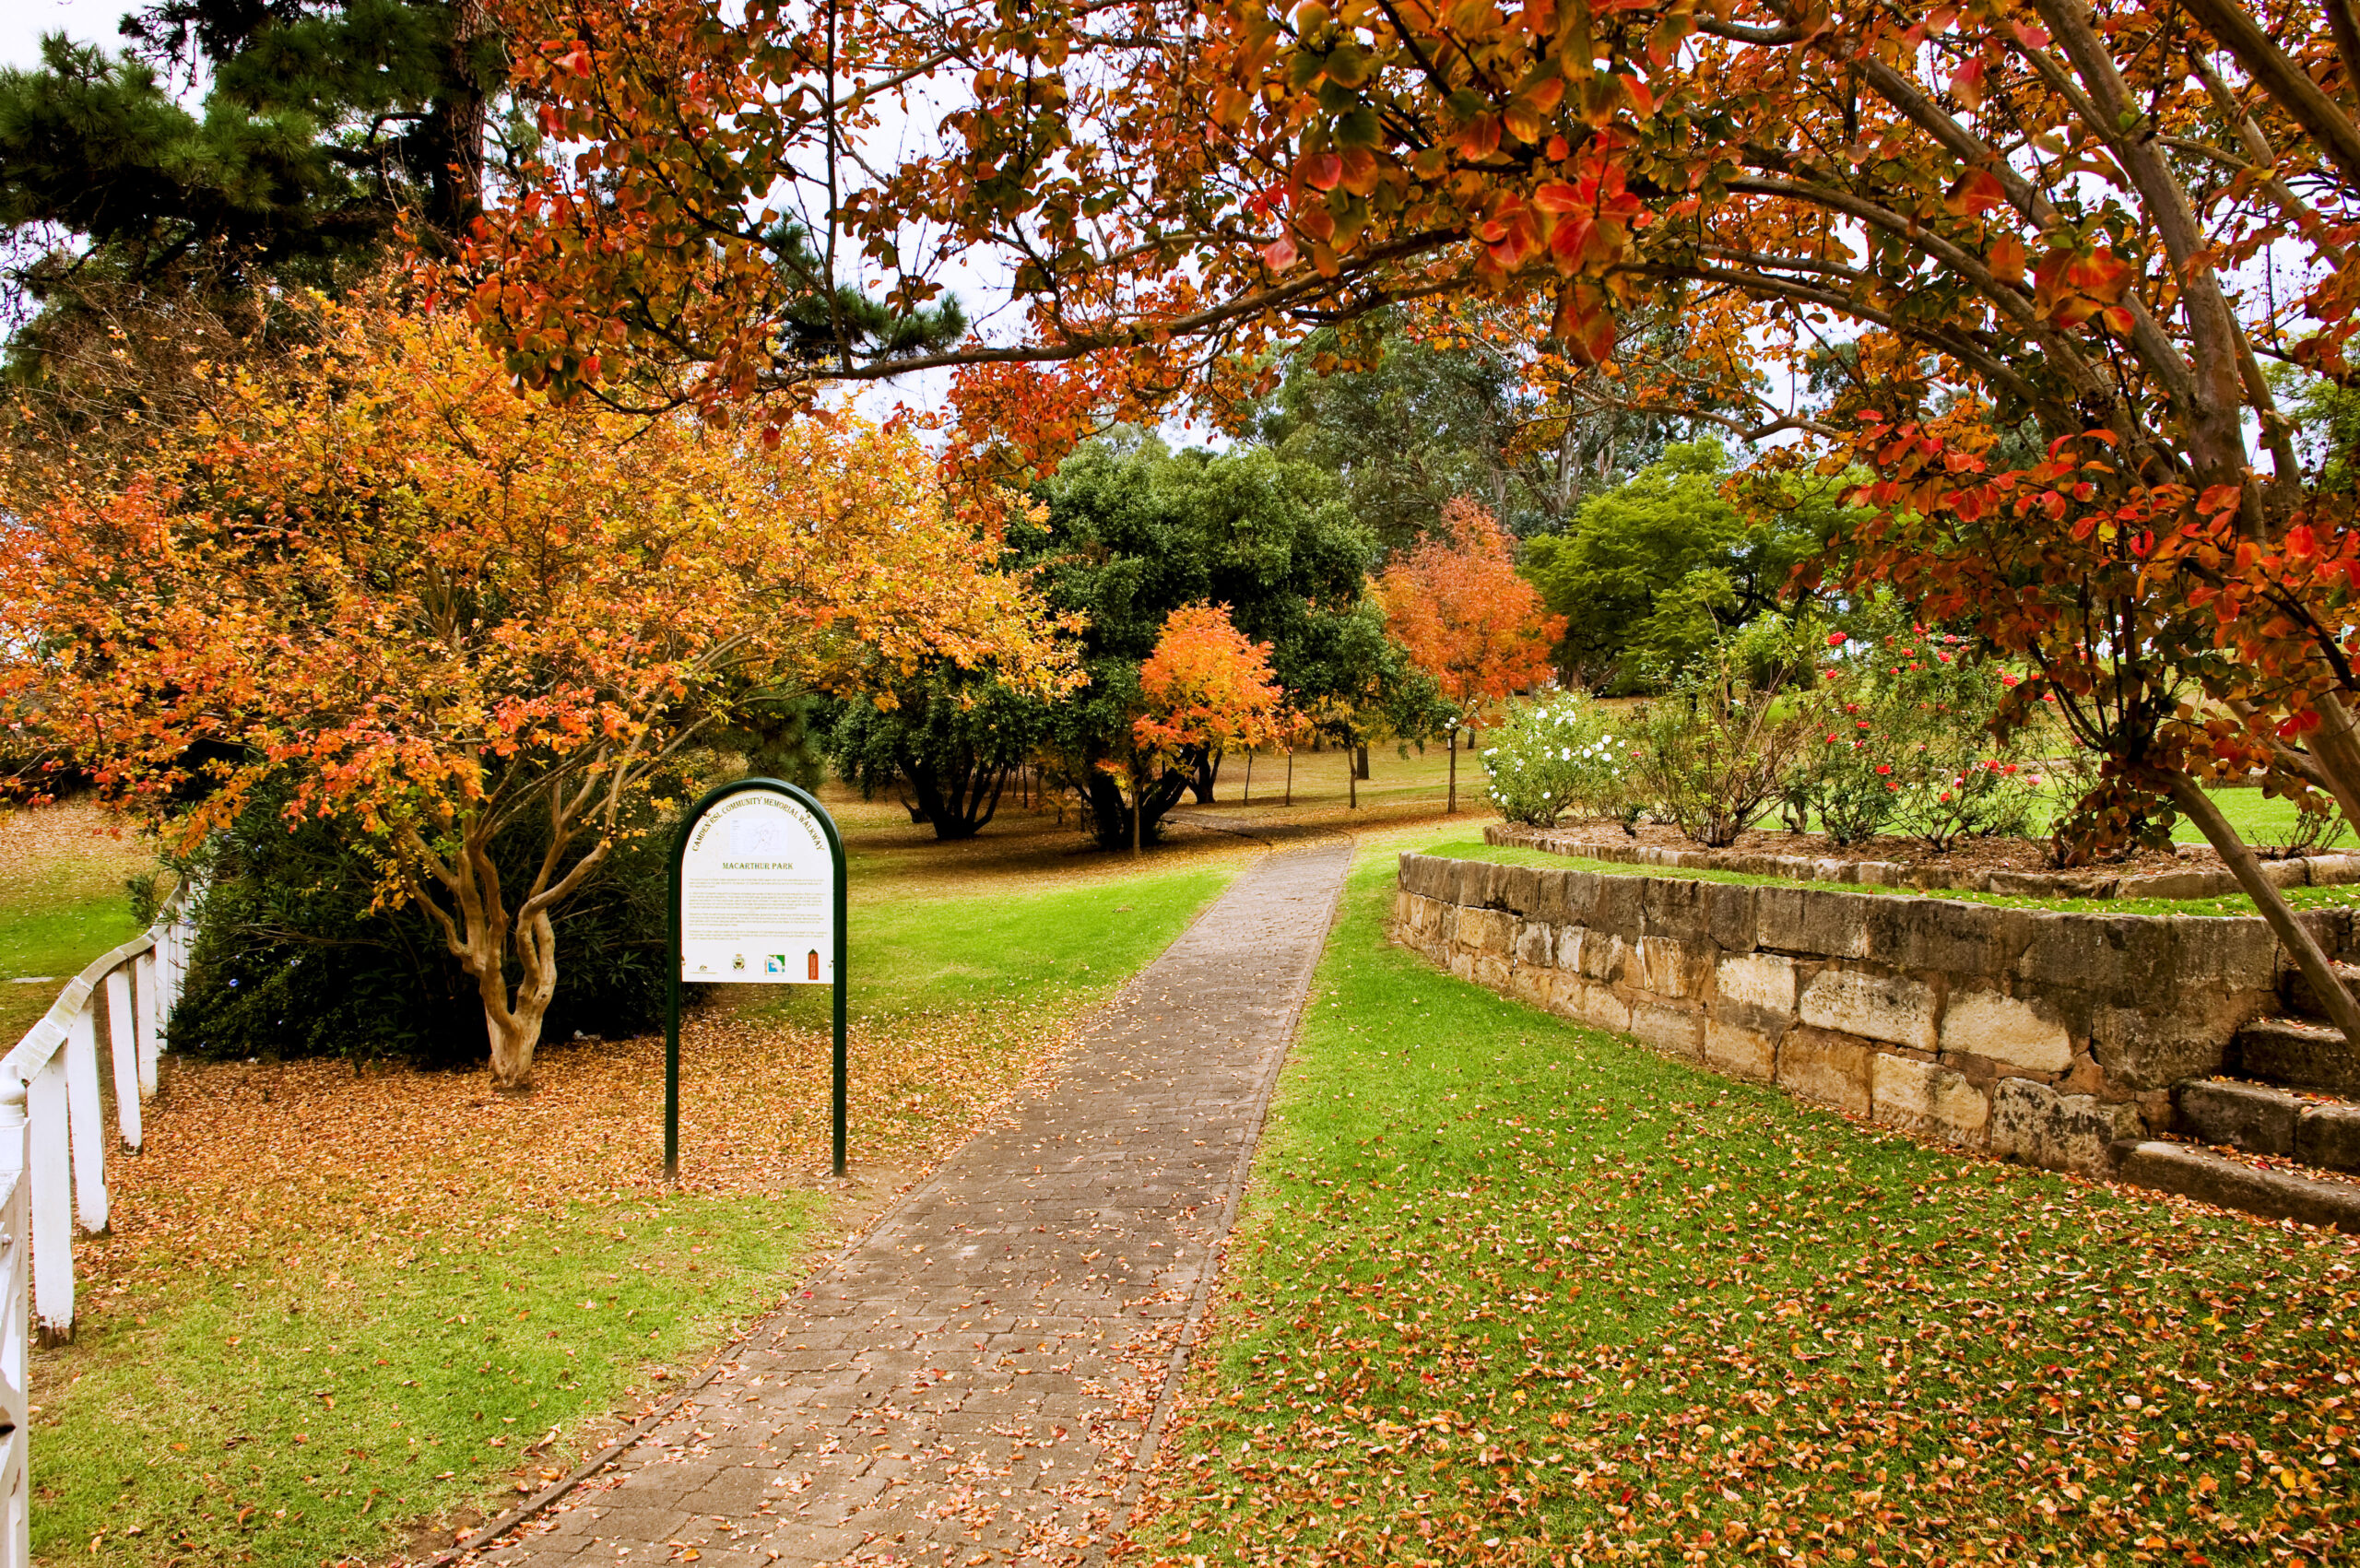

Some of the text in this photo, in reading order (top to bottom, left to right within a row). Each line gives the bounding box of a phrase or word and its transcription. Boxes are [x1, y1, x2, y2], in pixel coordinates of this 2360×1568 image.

[692, 820, 712, 852] CAMDEN
[709, 811, 723, 824] RSL
[722, 796, 763, 814] COMMUNITY
[763, 797, 799, 819] MEMORIAL
[798, 815, 825, 850] WALKWAY
[722, 862, 794, 870] MACARTHUR PARK
